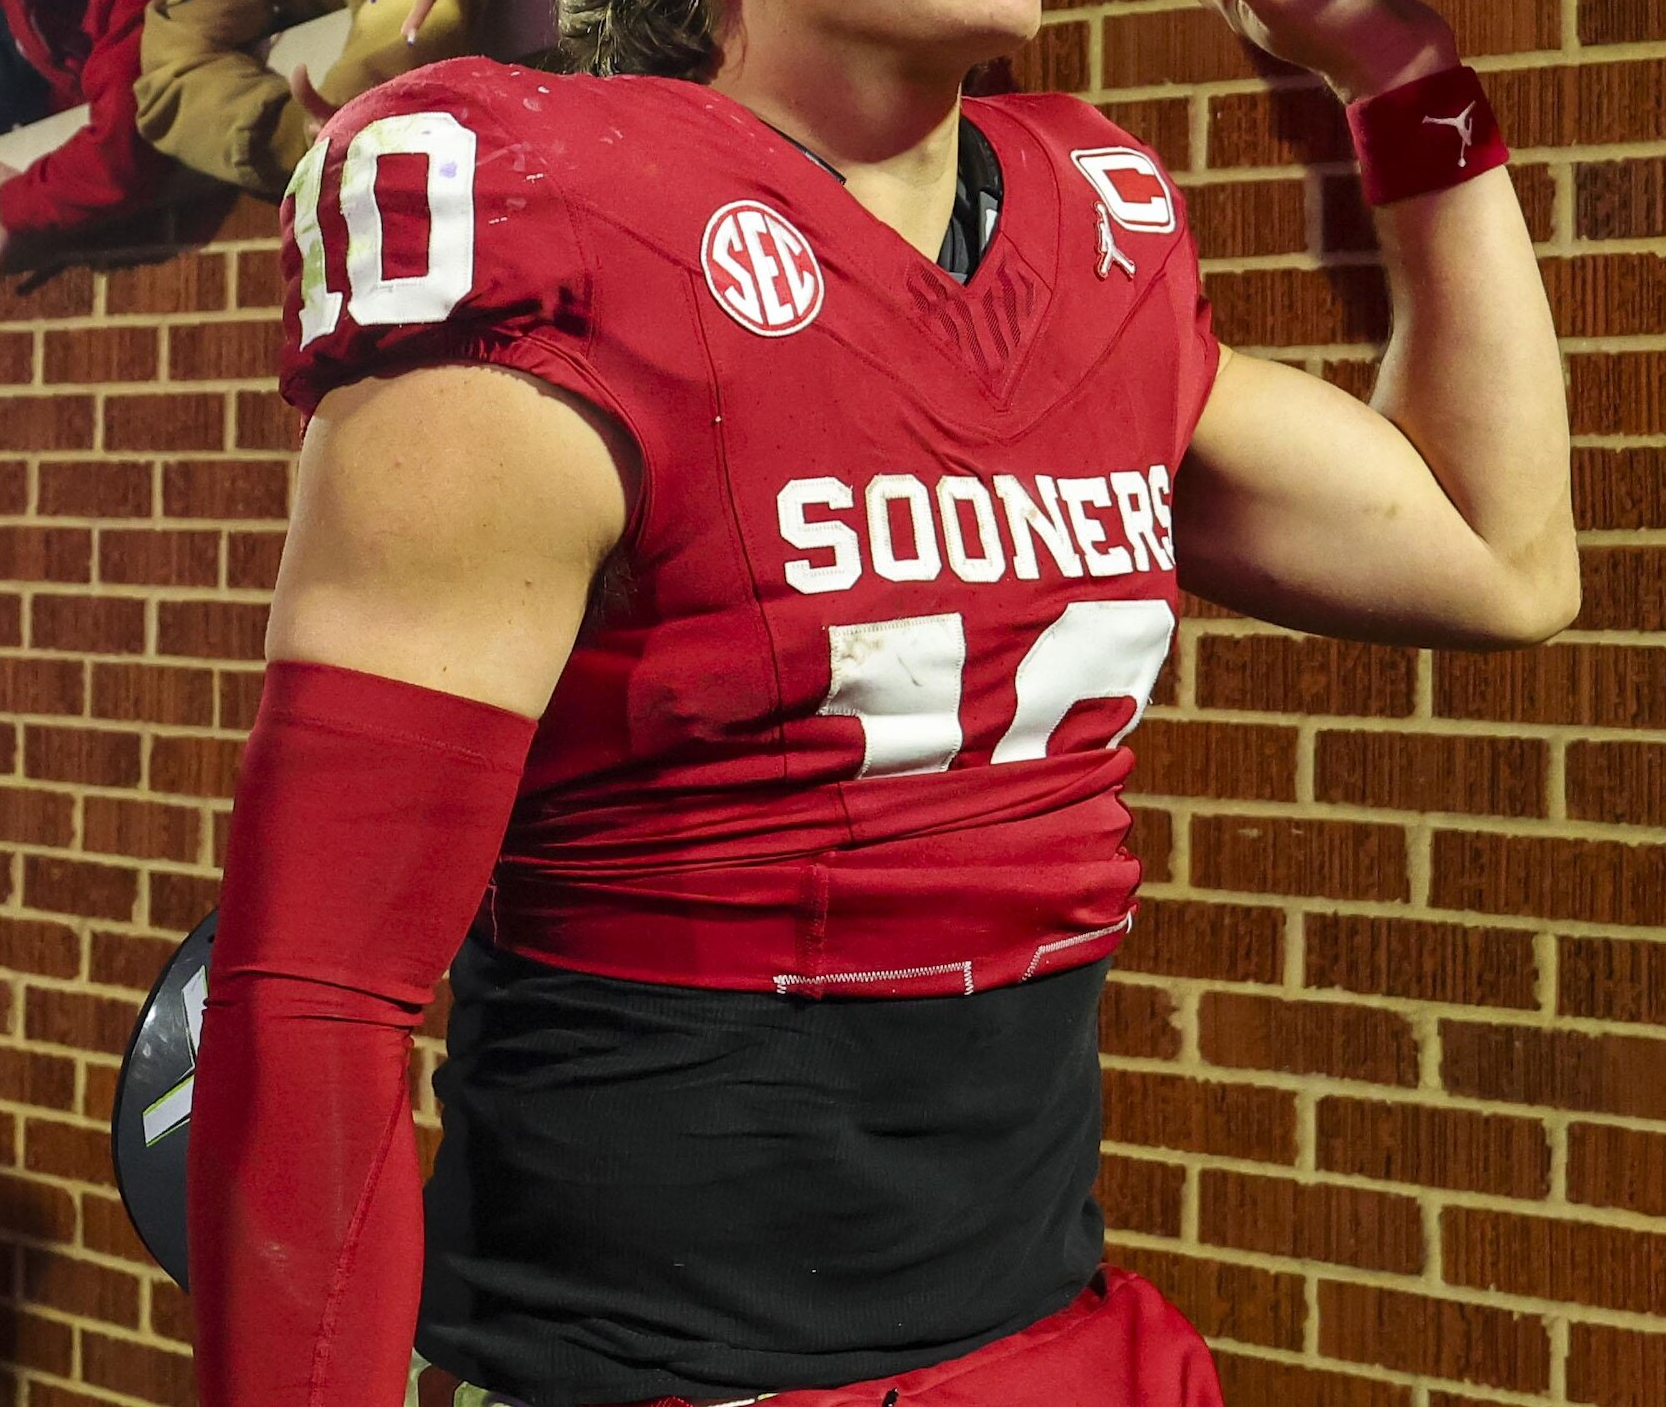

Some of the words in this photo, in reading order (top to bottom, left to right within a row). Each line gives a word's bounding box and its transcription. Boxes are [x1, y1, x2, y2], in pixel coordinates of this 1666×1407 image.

[283, 111, 477, 351] 10
[1096, 156, 1170, 225] C
[711, 212, 817, 326] SEC
[776, 465, 1174, 593] SOONERS
